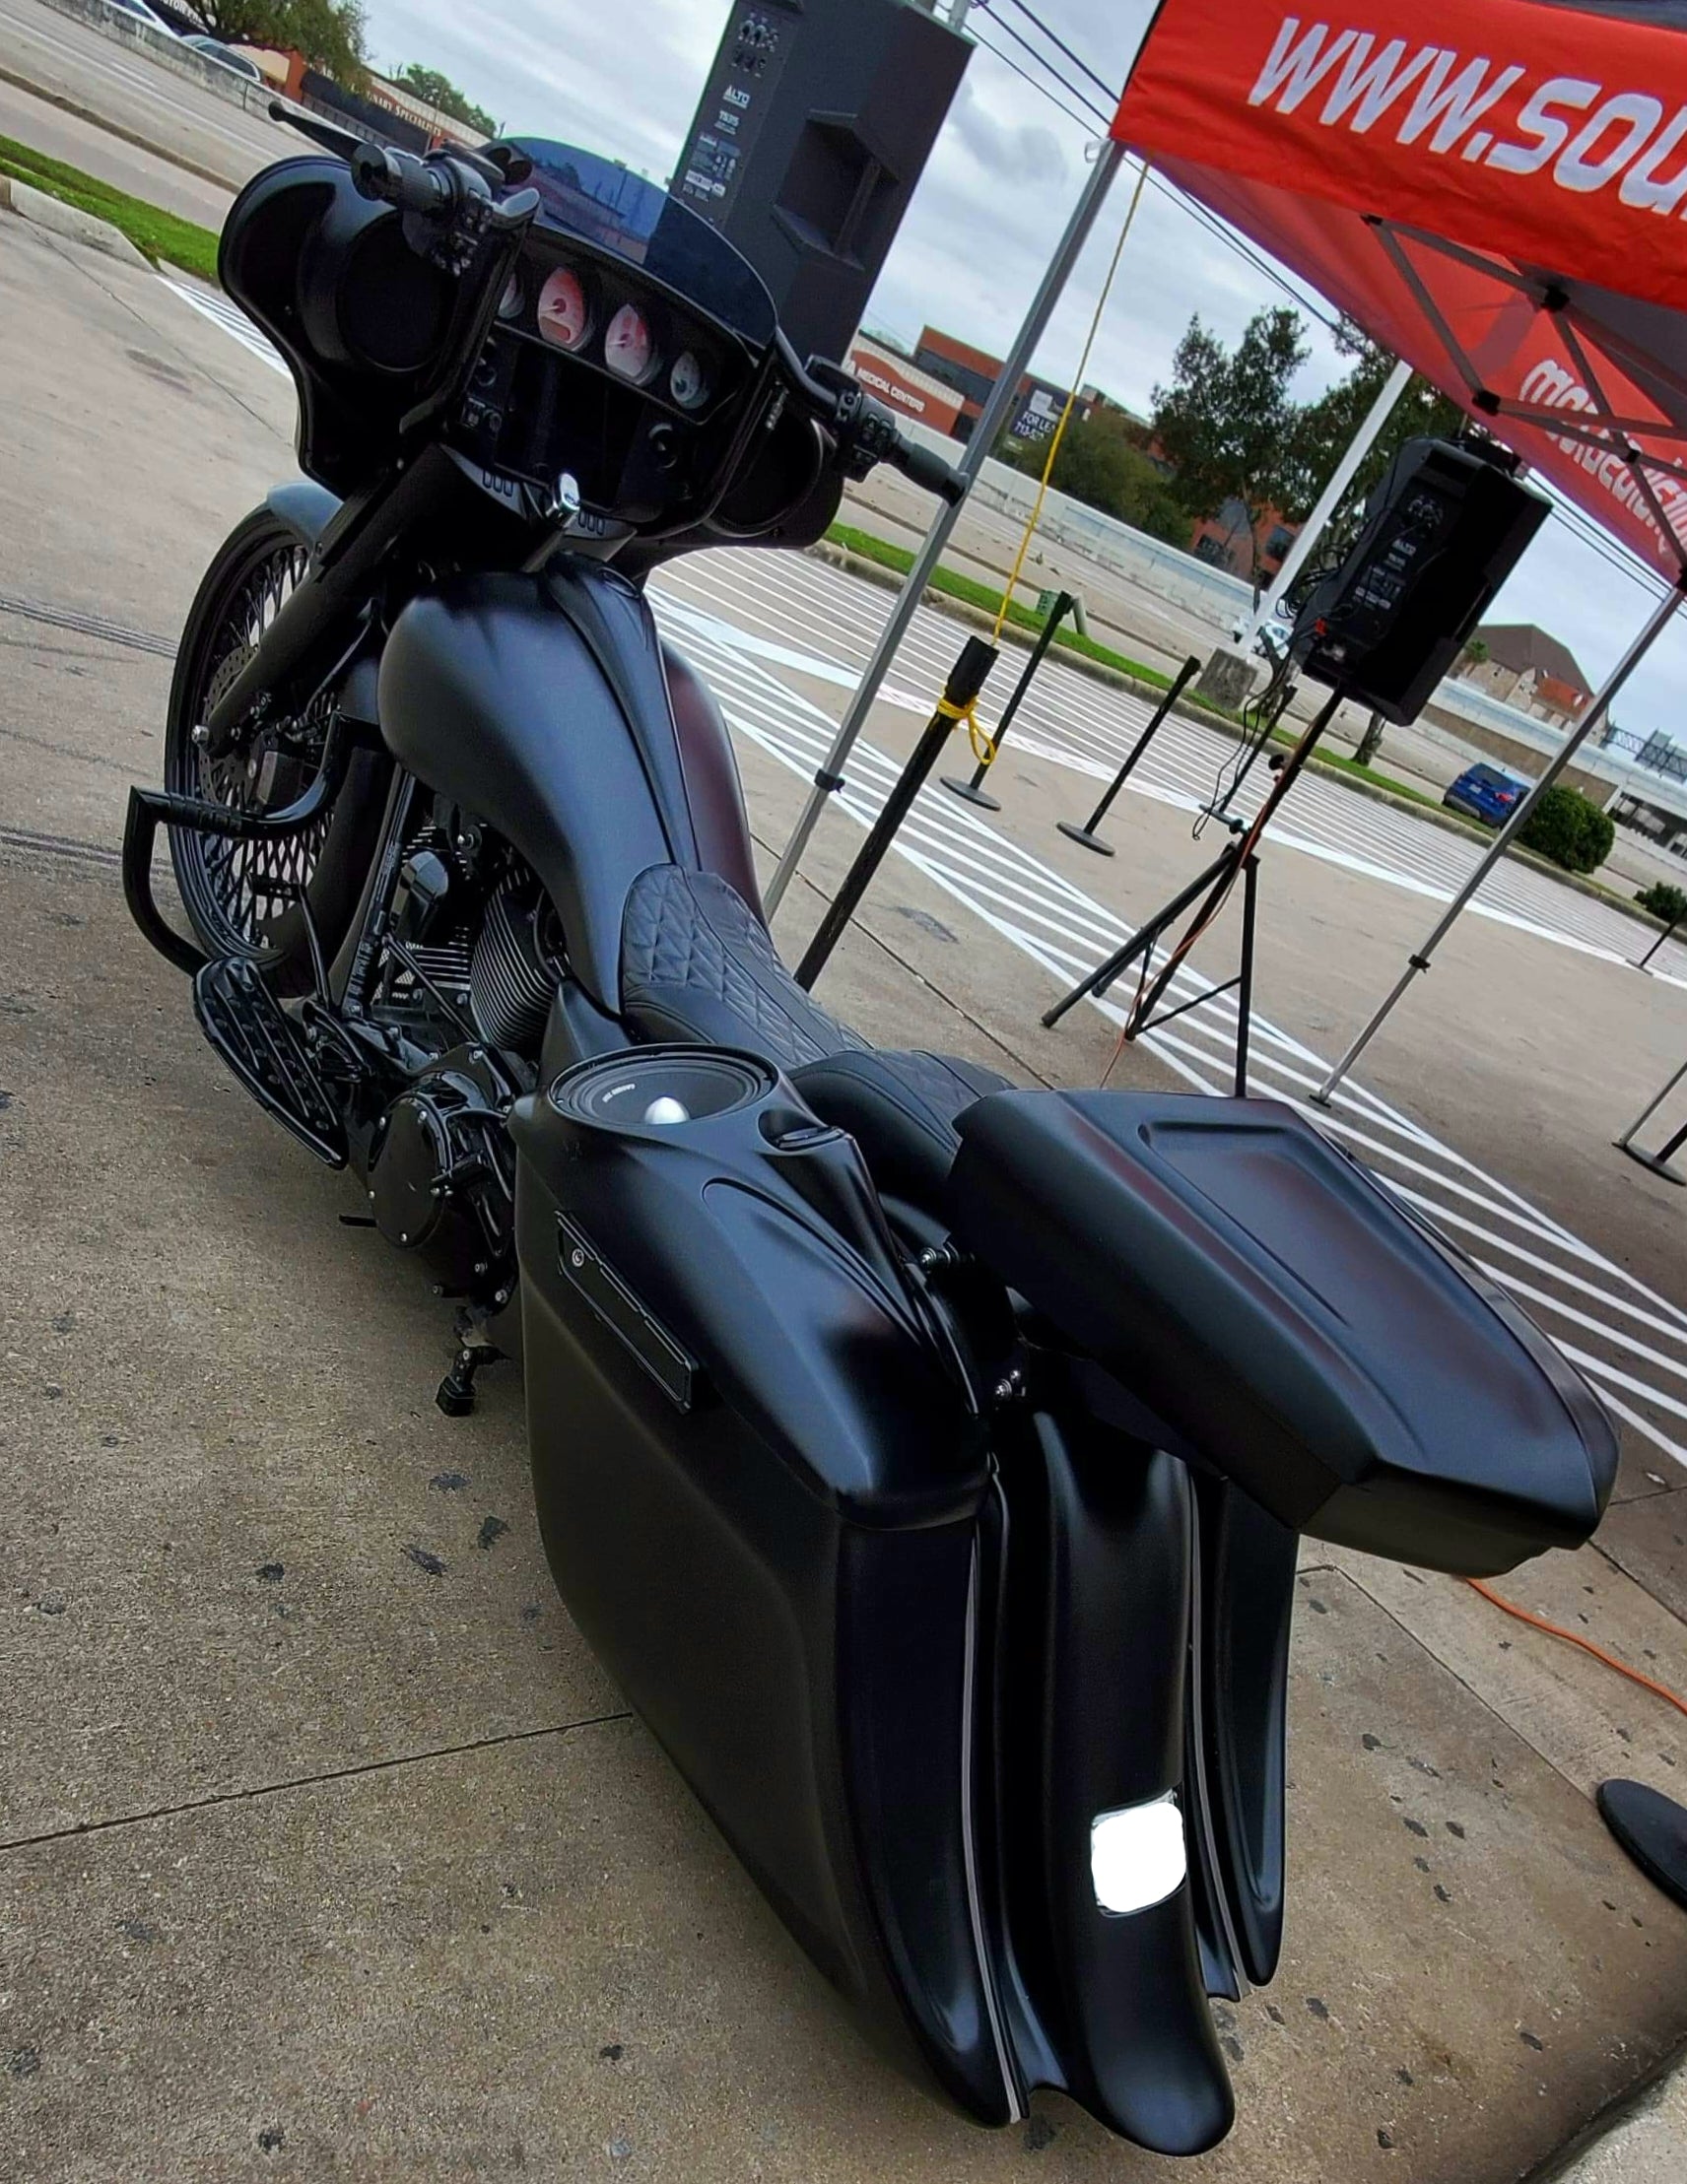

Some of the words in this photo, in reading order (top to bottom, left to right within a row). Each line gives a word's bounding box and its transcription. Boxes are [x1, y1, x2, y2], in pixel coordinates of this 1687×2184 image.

[723, 85, 750, 105] ALTO
[1248, 17, 1687, 222] www.sou
[856, 367, 891, 394] MEDICAL
[1022, 411, 1041, 428] FOR
